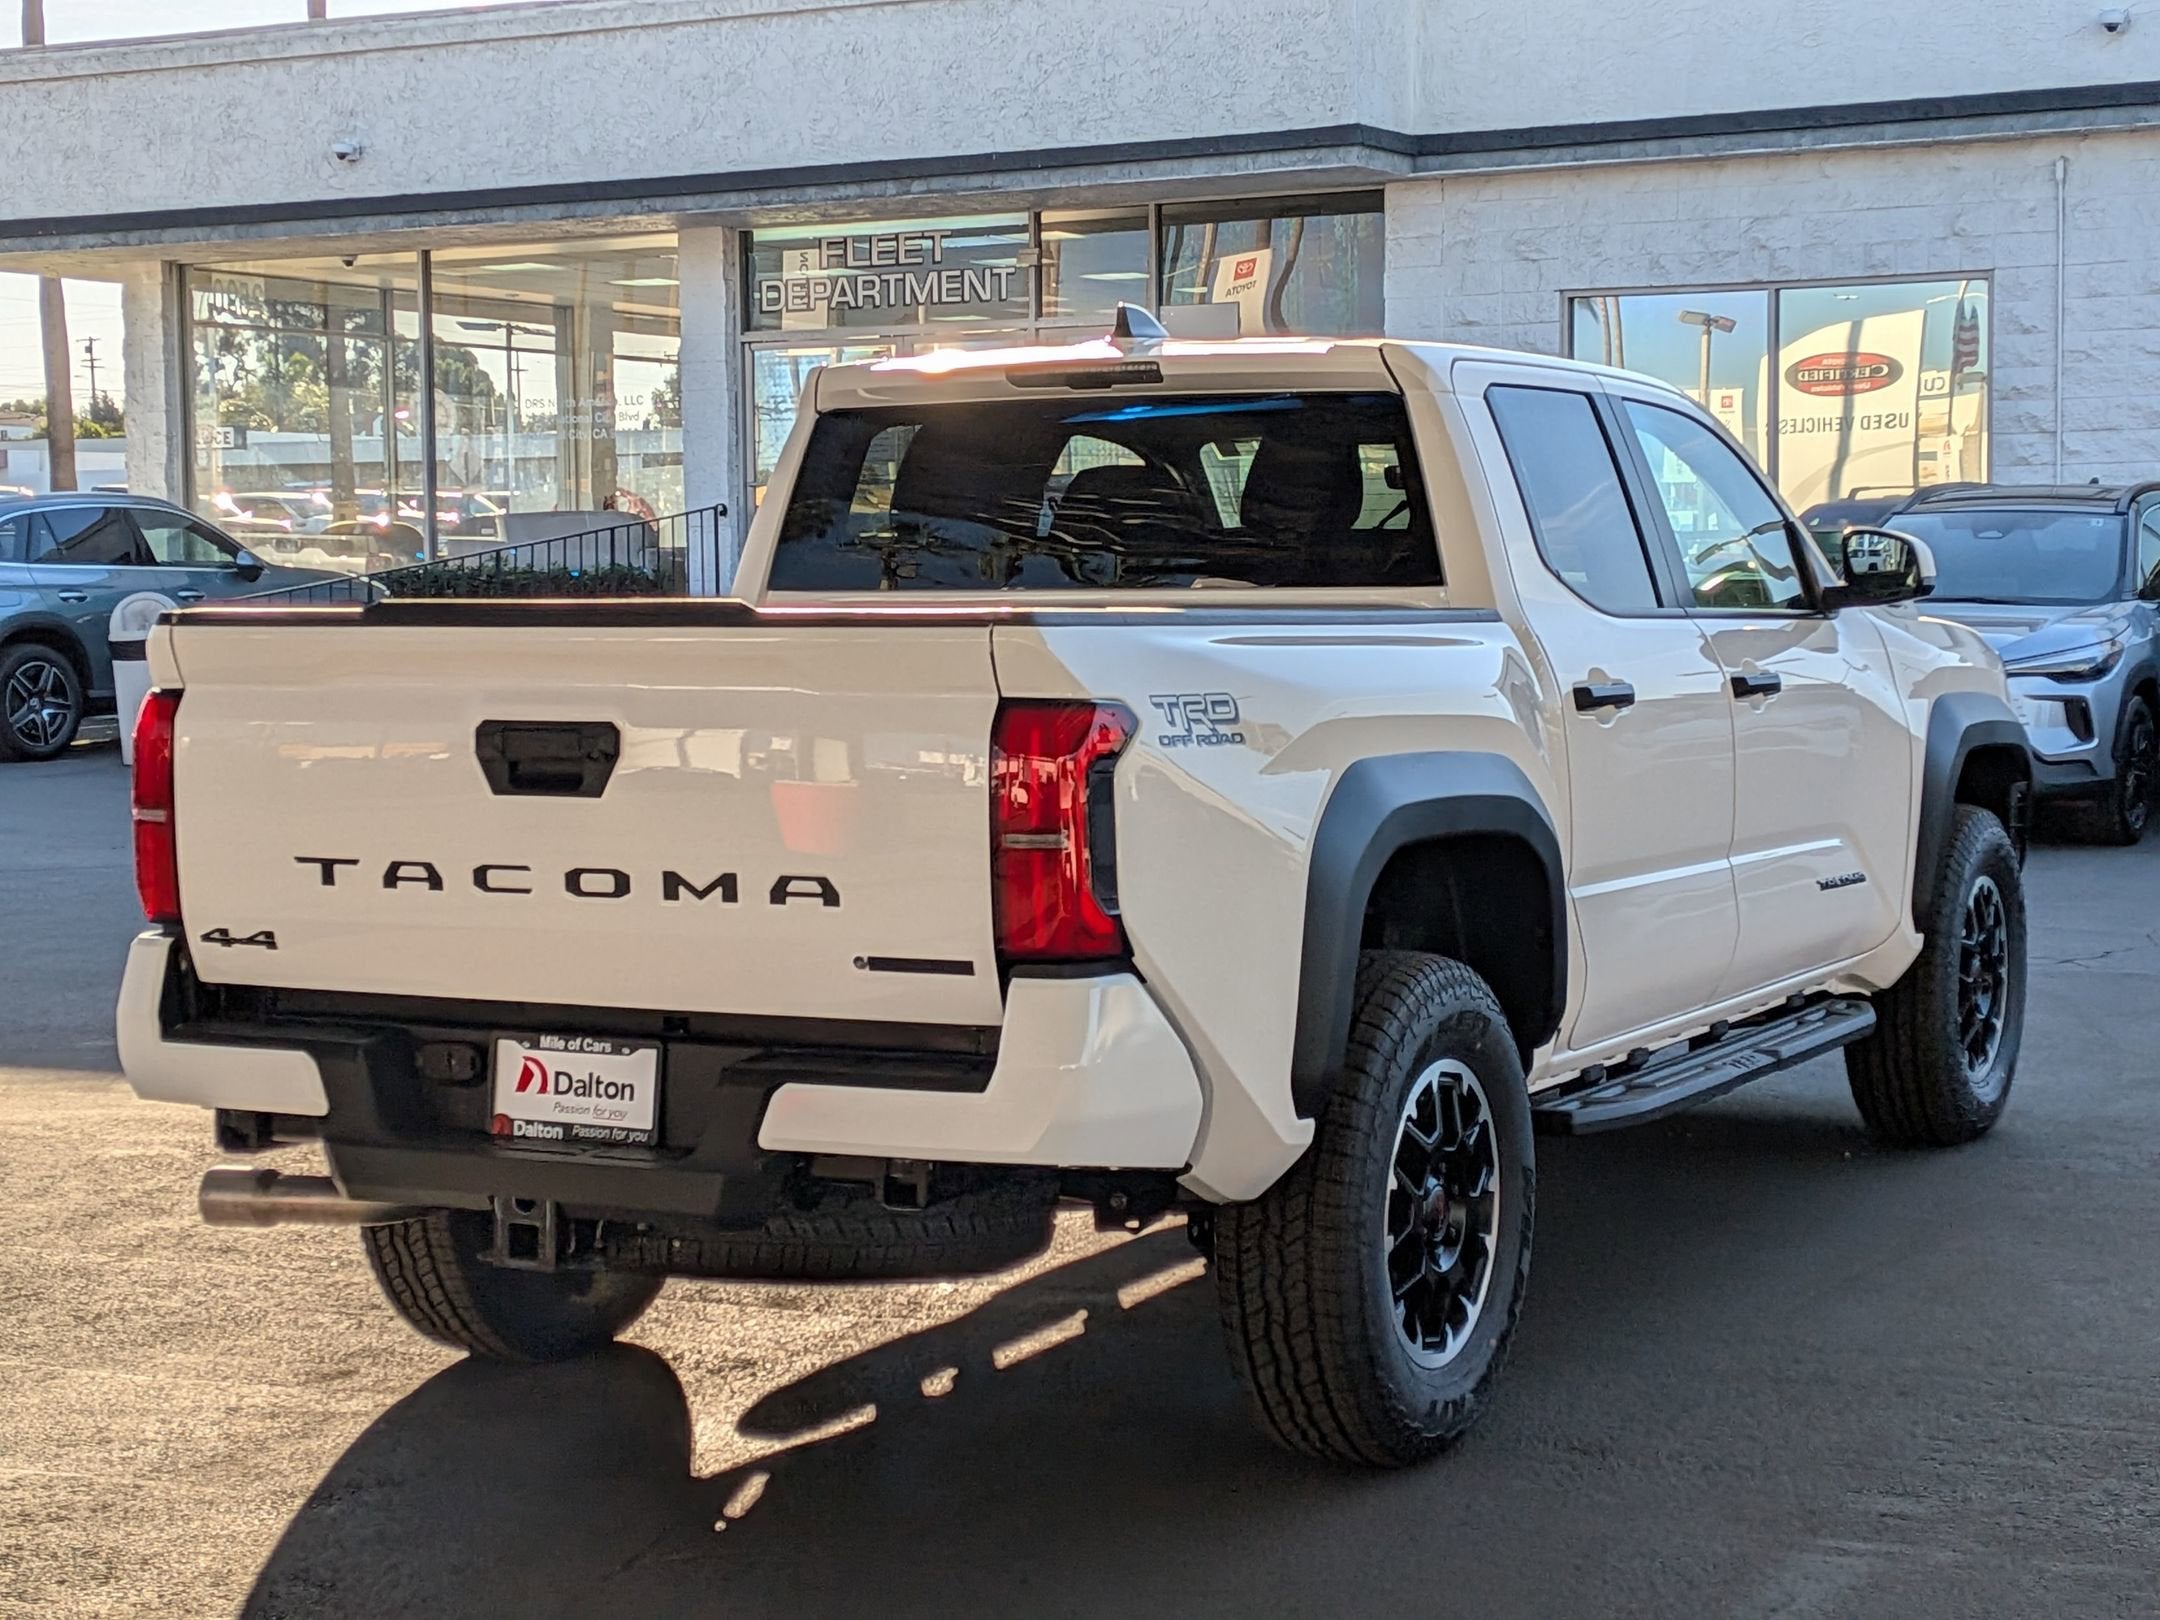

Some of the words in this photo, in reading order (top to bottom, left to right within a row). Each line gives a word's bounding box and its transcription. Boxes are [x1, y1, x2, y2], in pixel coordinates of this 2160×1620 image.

[819, 230, 952, 268] FLEET
[759, 267, 1016, 313] DEPARTMENT
[624, 395, 644, 406] LLC
[618, 411, 640, 422] Blvd
[1148, 692, 1240, 734] TRD
[1158, 734, 1195, 747] OFF
[1196, 732, 1246, 747] ROAD
[293, 856, 841, 908] TACOMA
[540, 1034, 565, 1050] Mile
[567, 1037, 582, 1051] of
[583, 1038, 612, 1053] Cars
[554, 1071, 635, 1102] Dalton
[552, 1101, 591, 1116] Passion
[593, 1103, 607, 1117] for
[608, 1108, 628, 1120] you
[513, 1120, 564, 1140] Dalton
[572, 1124, 611, 1139] Passion
[611, 1127, 627, 1140] for
[628, 1130, 649, 1143] you
